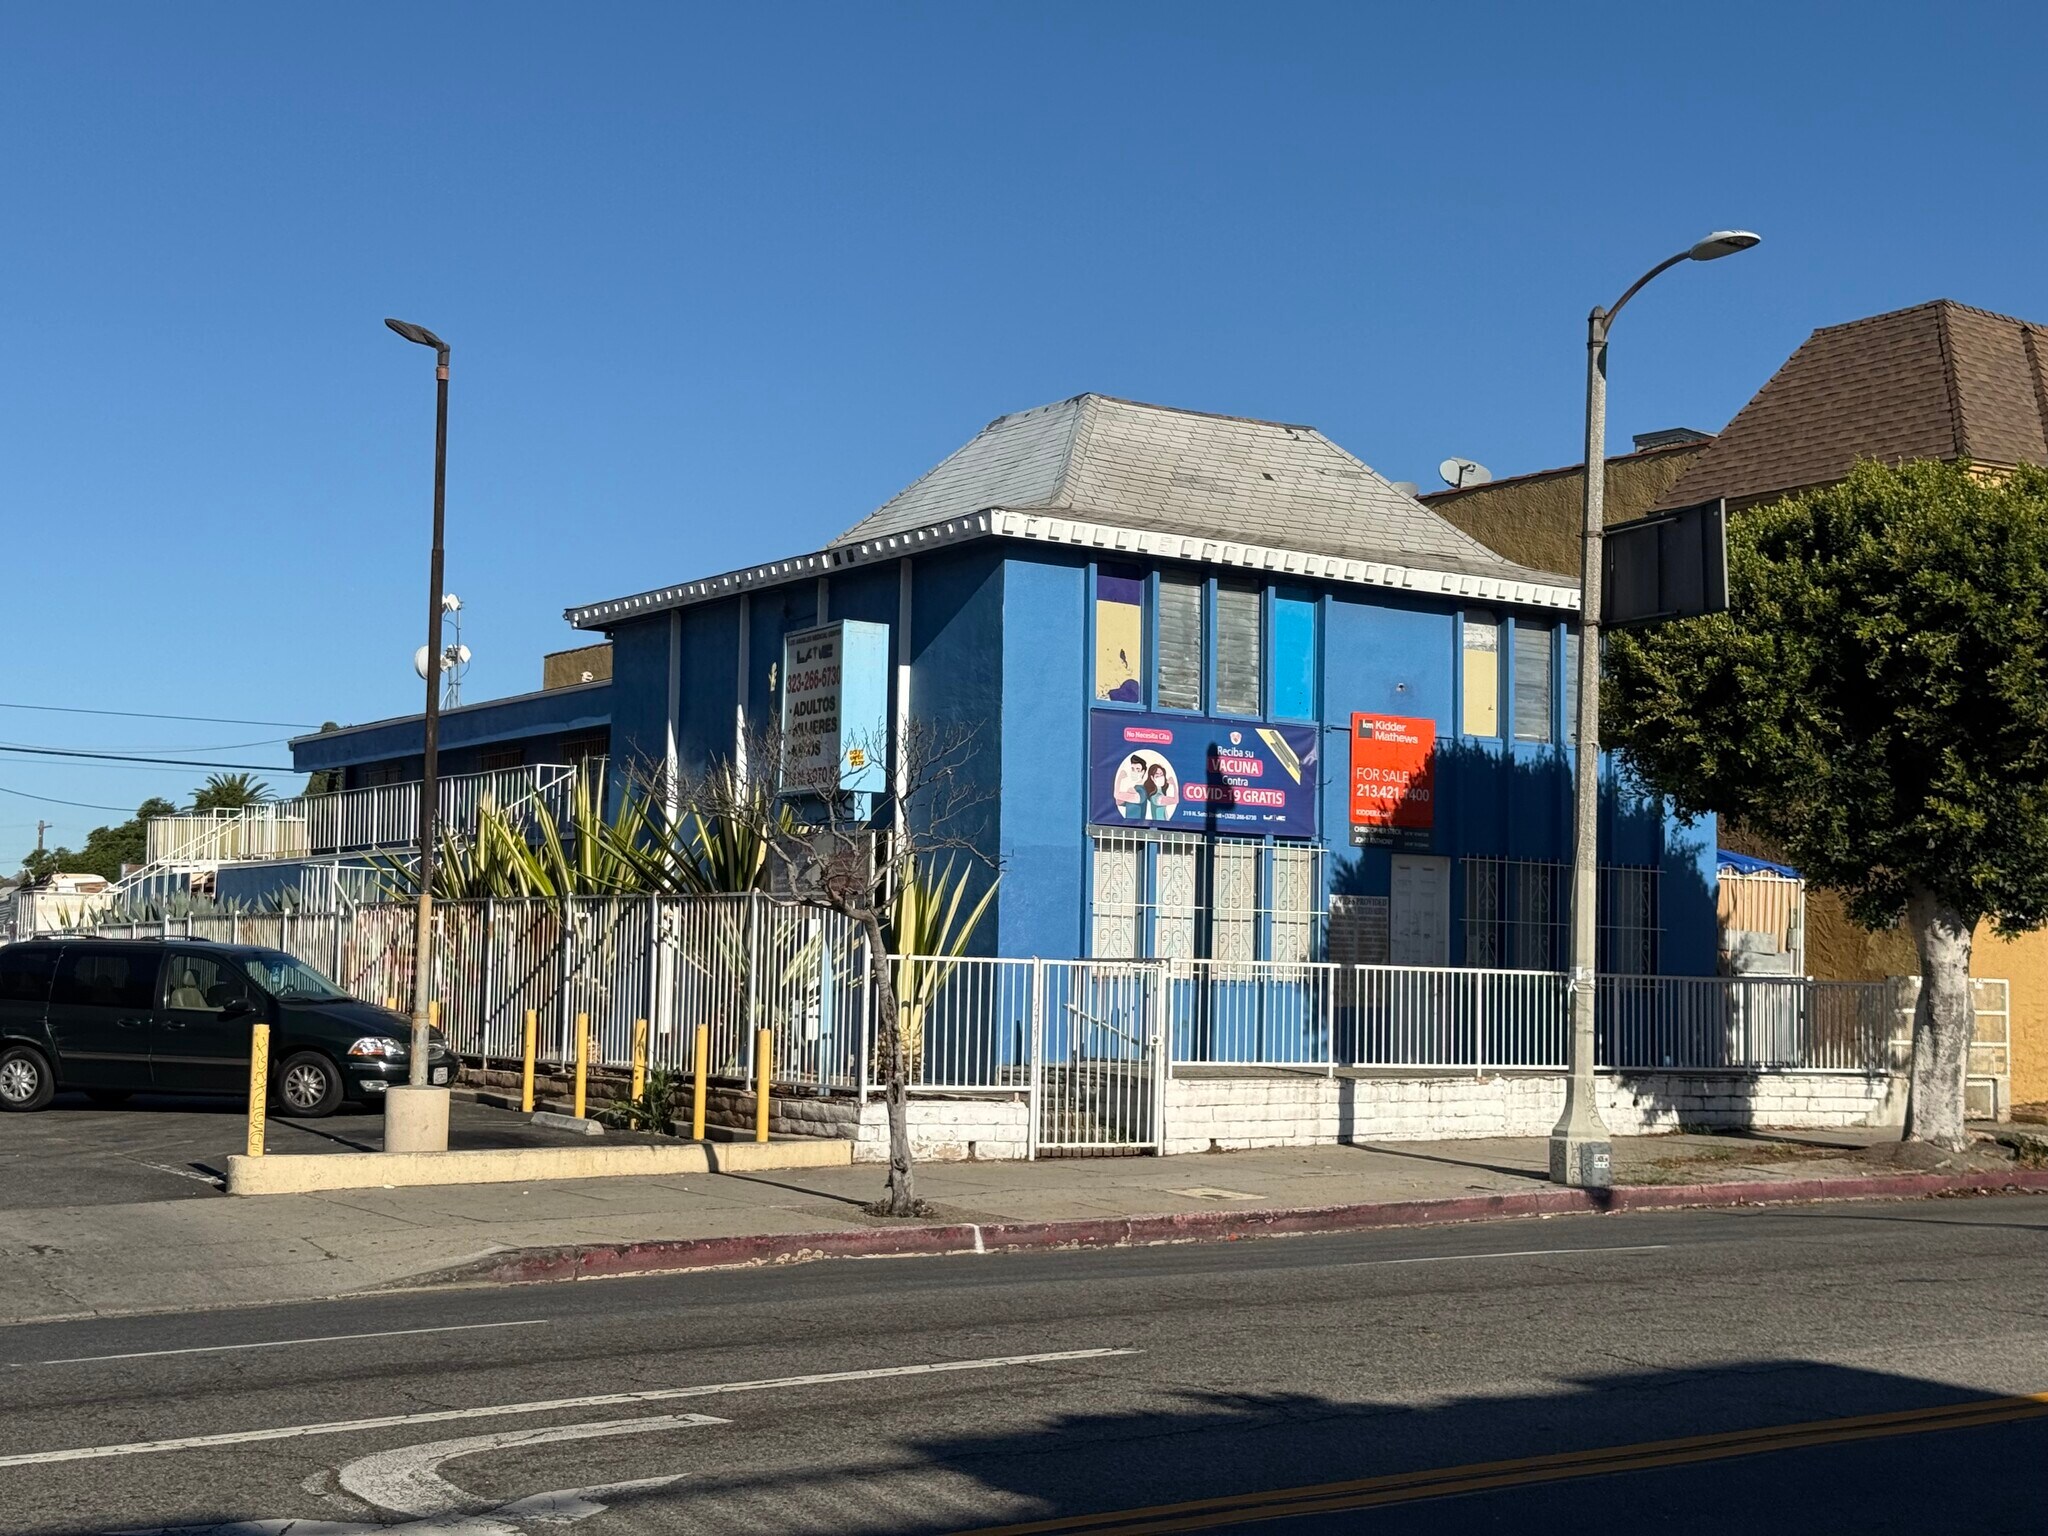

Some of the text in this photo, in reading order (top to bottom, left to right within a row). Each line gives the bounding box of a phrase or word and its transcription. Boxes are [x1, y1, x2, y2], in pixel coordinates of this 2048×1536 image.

[787, 664, 841, 694] 323-266-6730
[793, 695, 836, 717] ADULTOS
[1375, 720, 1406, 732] Kidder
[1126, 730, 1170, 741] No Necesita Cita
[1375, 731, 1419, 744] Mathews
[1217, 746, 1254, 758] Reciba su
[1211, 758, 1259, 774] VACUNA
[1222, 775, 1249, 787] Contra
[1356, 767, 1410, 784] FOR SALE
[1186, 786, 1283, 805] COVID-19 GRATIS
[1356, 784, 1430, 802] 213.421.1400
